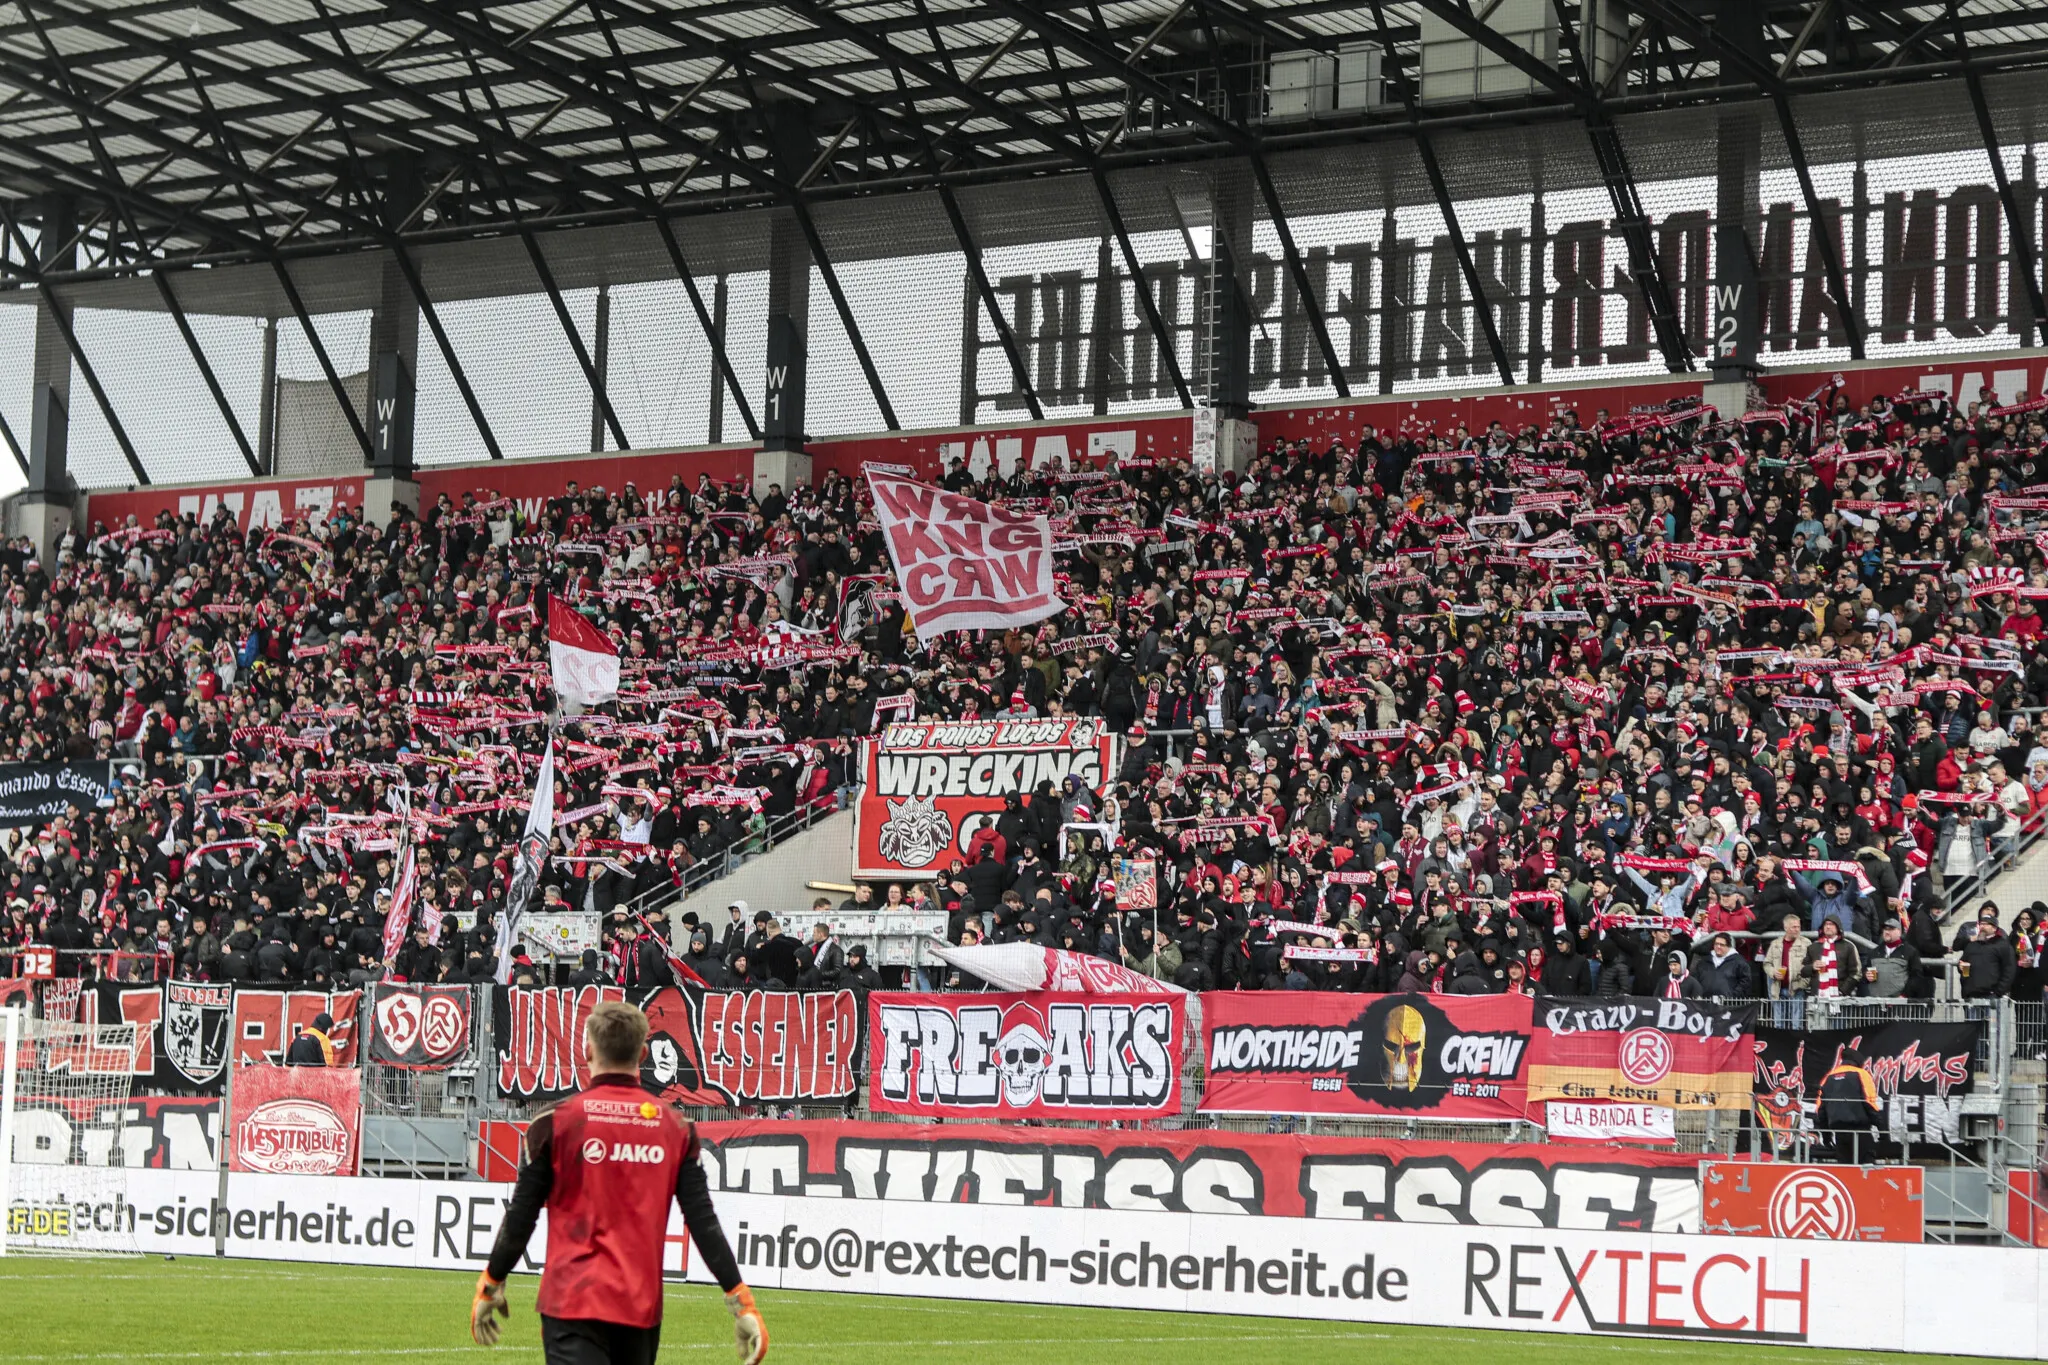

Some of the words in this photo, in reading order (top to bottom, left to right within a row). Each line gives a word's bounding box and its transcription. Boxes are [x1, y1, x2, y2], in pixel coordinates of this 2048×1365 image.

[1717, 284, 1743, 311] W
[1718, 317, 1738, 349] 2
[768, 366, 787, 389] W
[377, 399, 396, 421] W
[889, 520, 1044, 568] KNG
[879, 751, 1100, 797] WRECKING
[499, 984, 627, 1096] JUNG
[700, 987, 858, 1100] ESSENER
[1211, 1026, 1363, 1073] NORTHSIDE
[1440, 1033, 1525, 1077] CREW
[1312, 1077, 1342, 1092] ESSEN
[1453, 1082, 1477, 1097] EST.
[586, 1101, 637, 1115] SCHULTE
[1563, 1107, 1583, 1127] LA
[1589, 1107, 1637, 1128] BANDA
[1643, 1108, 1654, 1127] E
[587, 1114, 661, 1128] Immobilien-Gruppe
[239, 1120, 347, 1156] WESTTRIBÜNE
[609, 1142, 665, 1165] JAKO
[269, 1157, 328, 1174] Essen
[12, 1192, 415, 1248] ech-sicherheit.de
[737, 1221, 1409, 1301] info@rextech-sicherheit.de
[1464, 1242, 1810, 1341] REXTECH
